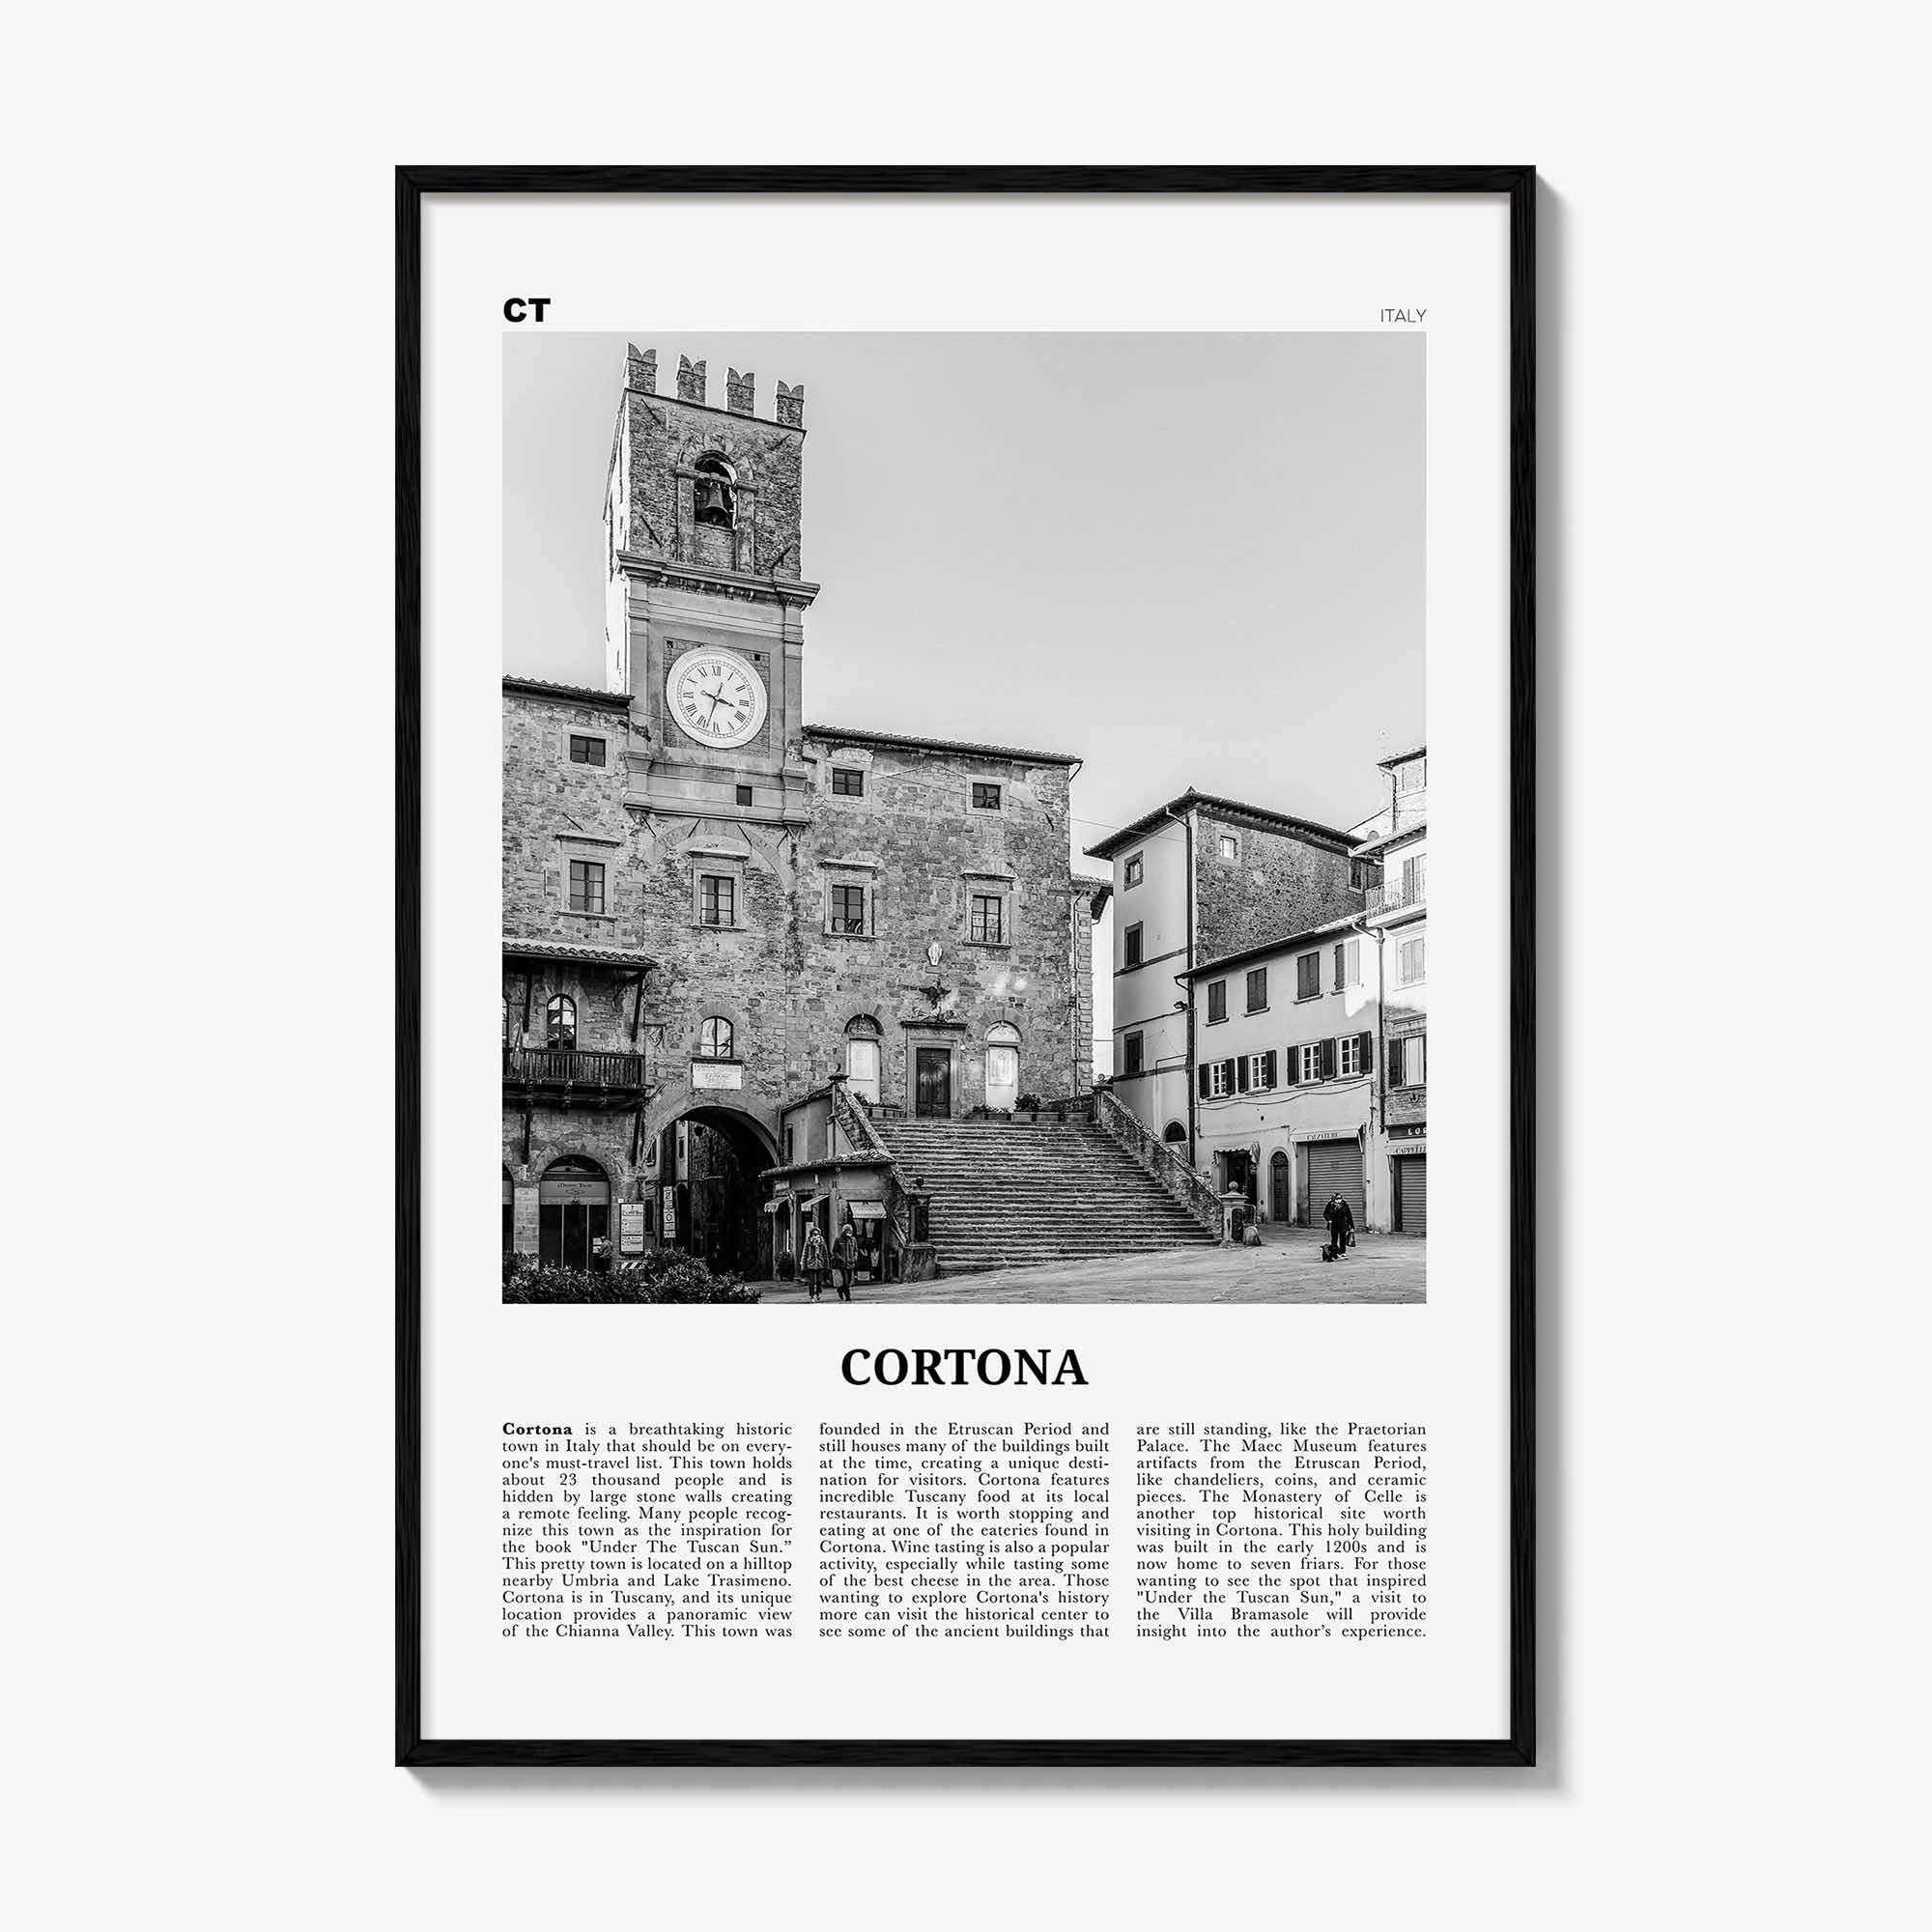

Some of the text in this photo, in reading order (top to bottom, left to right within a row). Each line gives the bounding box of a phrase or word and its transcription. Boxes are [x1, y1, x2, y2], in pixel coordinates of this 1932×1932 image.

[503, 298, 552, 323] CT
[1380, 308, 1427, 323] ITALY
[840, 1348, 1090, 1386] CORTONA
[502, 1423, 792, 1439] Cortona is a breathtaking historic
[819, 1423, 1110, 1435] founded in the Etruscan Period and
[1136, 1423, 1427, 1439] are still standing, like the Praetorian
[501, 1457, 793, 1469] one's must-travel list. This town holds
[819, 1457, 1109, 1473] at the time, creating a unique desti-
[1136, 1457, 1427, 1473] artifacts from the Etruscan Period,
[502, 1490, 793, 1506] hidden by large stone walls creating
[819, 1490, 1109, 1506] incredible Tuscany food at its local
[1136, 1490, 1427, 1506] pieces. The Monastery of Celle is
[502, 1523, 793, 1540] nize this town as the inspiration for
[819, 1523, 1109, 1540] eating at one of the eateries found in
[1136, 1523, 1428, 1540] visiting in Cortona. This holy building
[501, 1557, 792, 1574] This pretty town is located on a hilltop
[819, 1557, 1110, 1574] activity, especially while tasting some
[1136, 1557, 1427, 1571] now home to seven friars. For those
[502, 1591, 792, 1607] Cortona is in Tuscany, and its unique
[819, 1591, 1110, 1607] wanting to explore Cortona's history
[1137, 1591, 1427, 1607] "Under the Tuscan Sun," a visit to
[501, 1625, 793, 1641] of the Chianna Valley. This town was
[819, 1625, 1110, 1641] see some of the ancient buildings that
[1136, 1625, 1427, 1641] insight into the author’s experience.
